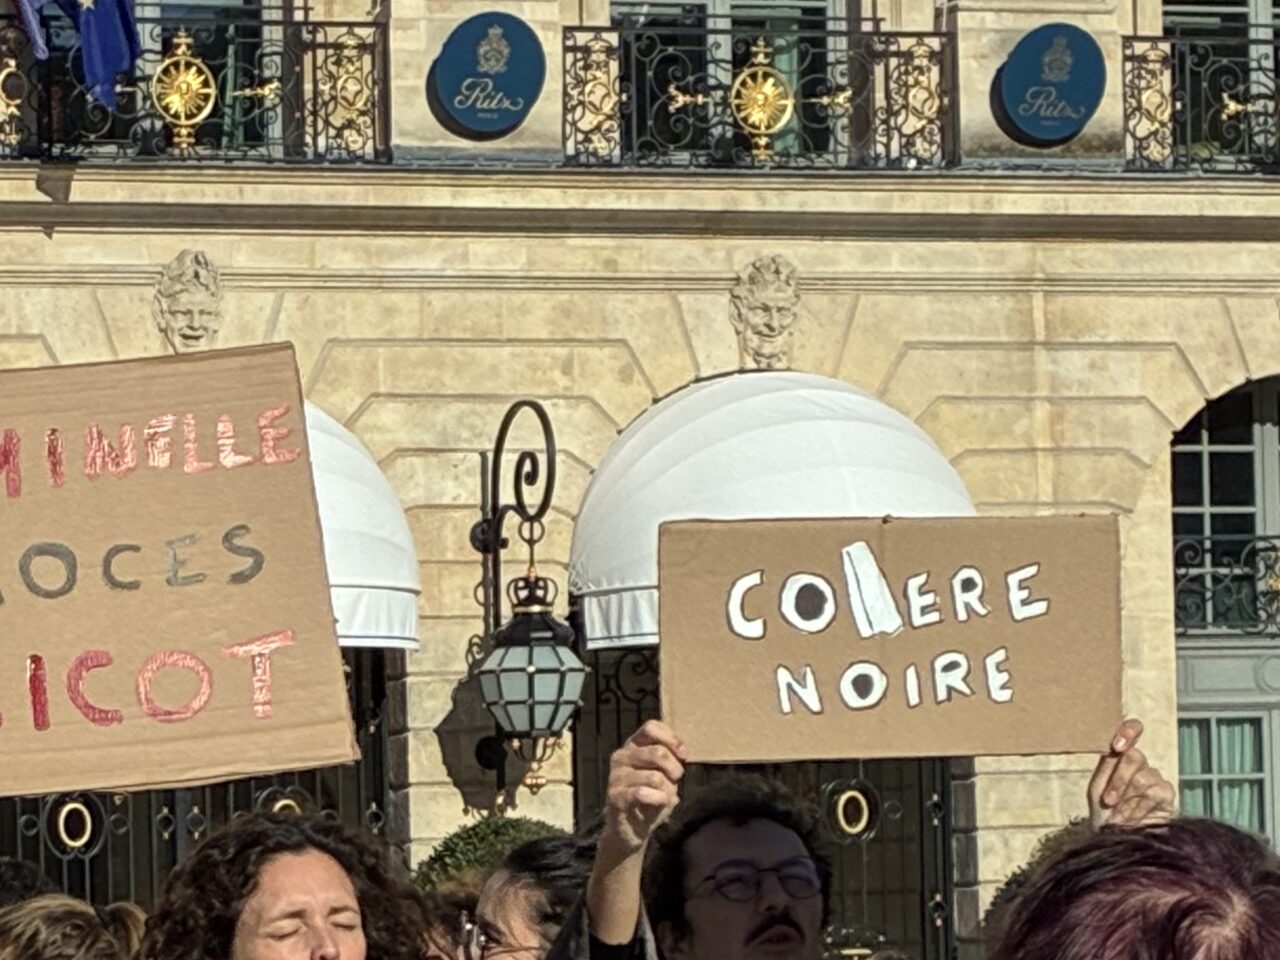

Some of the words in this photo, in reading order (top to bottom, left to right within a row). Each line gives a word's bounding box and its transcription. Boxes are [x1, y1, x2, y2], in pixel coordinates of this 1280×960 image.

[454, 77, 524, 111] Ritz
[1018, 86, 1087, 119] Ritz
[774, 646, 1014, 715] NOIRE
